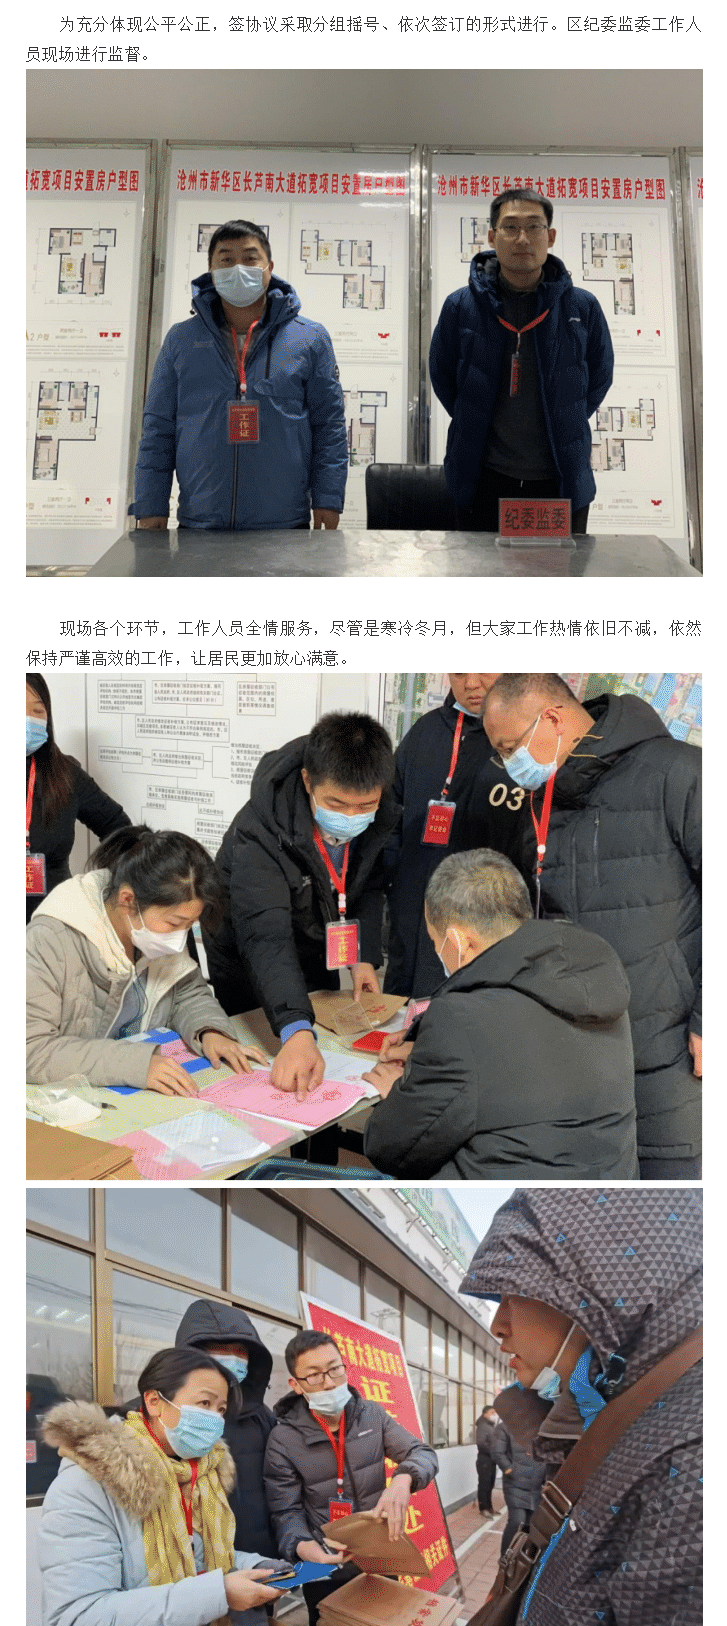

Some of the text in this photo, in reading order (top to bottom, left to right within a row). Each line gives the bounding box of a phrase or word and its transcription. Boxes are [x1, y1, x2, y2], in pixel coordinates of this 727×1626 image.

[26, 169, 140, 192] 拓宽项目安置房户型图
[504, 507, 566, 530] 纪委监委
[489, 783, 525, 811] 03
[360, 1376, 395, 1404] 证
